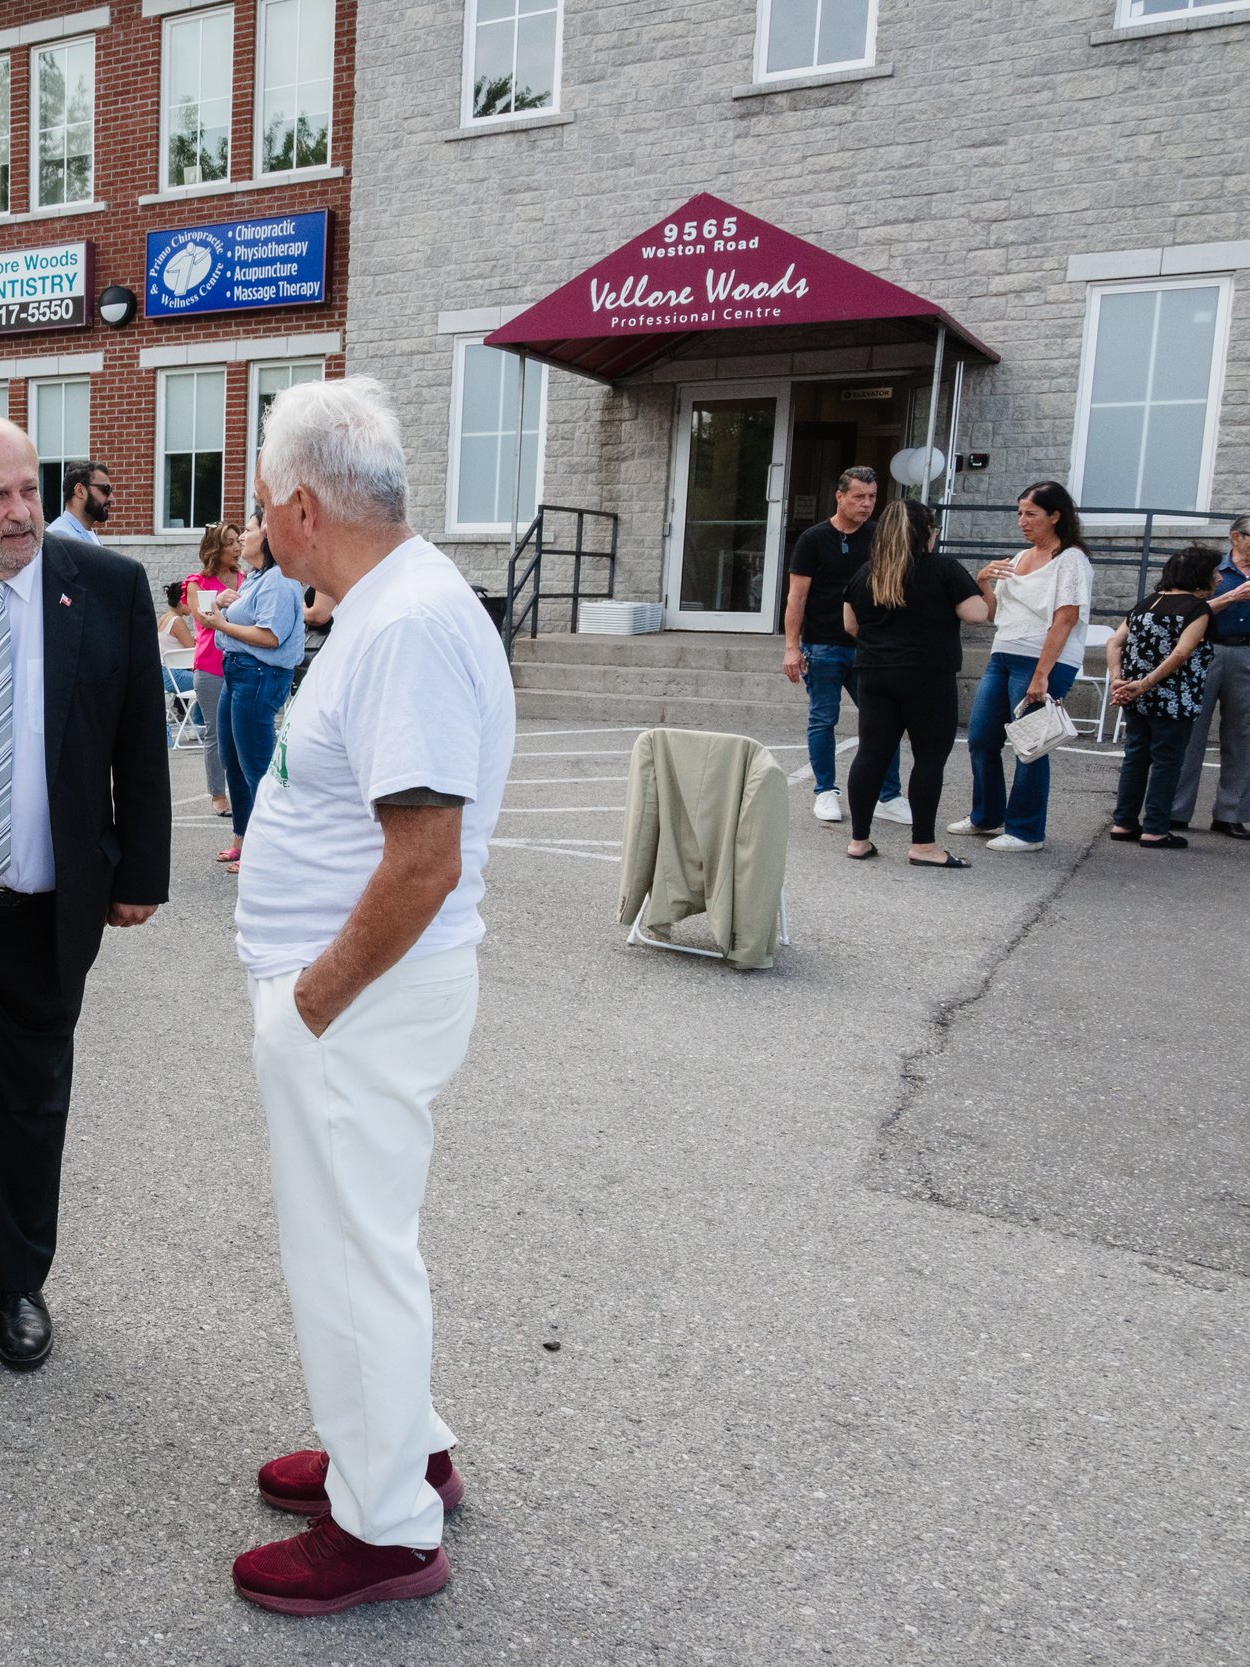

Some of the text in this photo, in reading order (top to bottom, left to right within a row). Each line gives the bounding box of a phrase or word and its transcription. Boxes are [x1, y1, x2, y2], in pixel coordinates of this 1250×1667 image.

[236, 219, 296, 241] Chiropractic
[664, 217, 737, 243] 9565
[149, 231, 223, 277] Primo Chiropractic
[235, 241, 308, 262] Physiotherapy
[642, 236, 759, 259] Weston Road
[24, 250, 78, 271] Woods
[234, 262, 298, 282] Acupuncture
[150, 262, 224, 309] & Wellness Centre
[234, 280, 320, 302] Massage Therapy
[590, 262, 809, 313] Vellore Woods
[611, 307, 781, 328] Professional Centre
